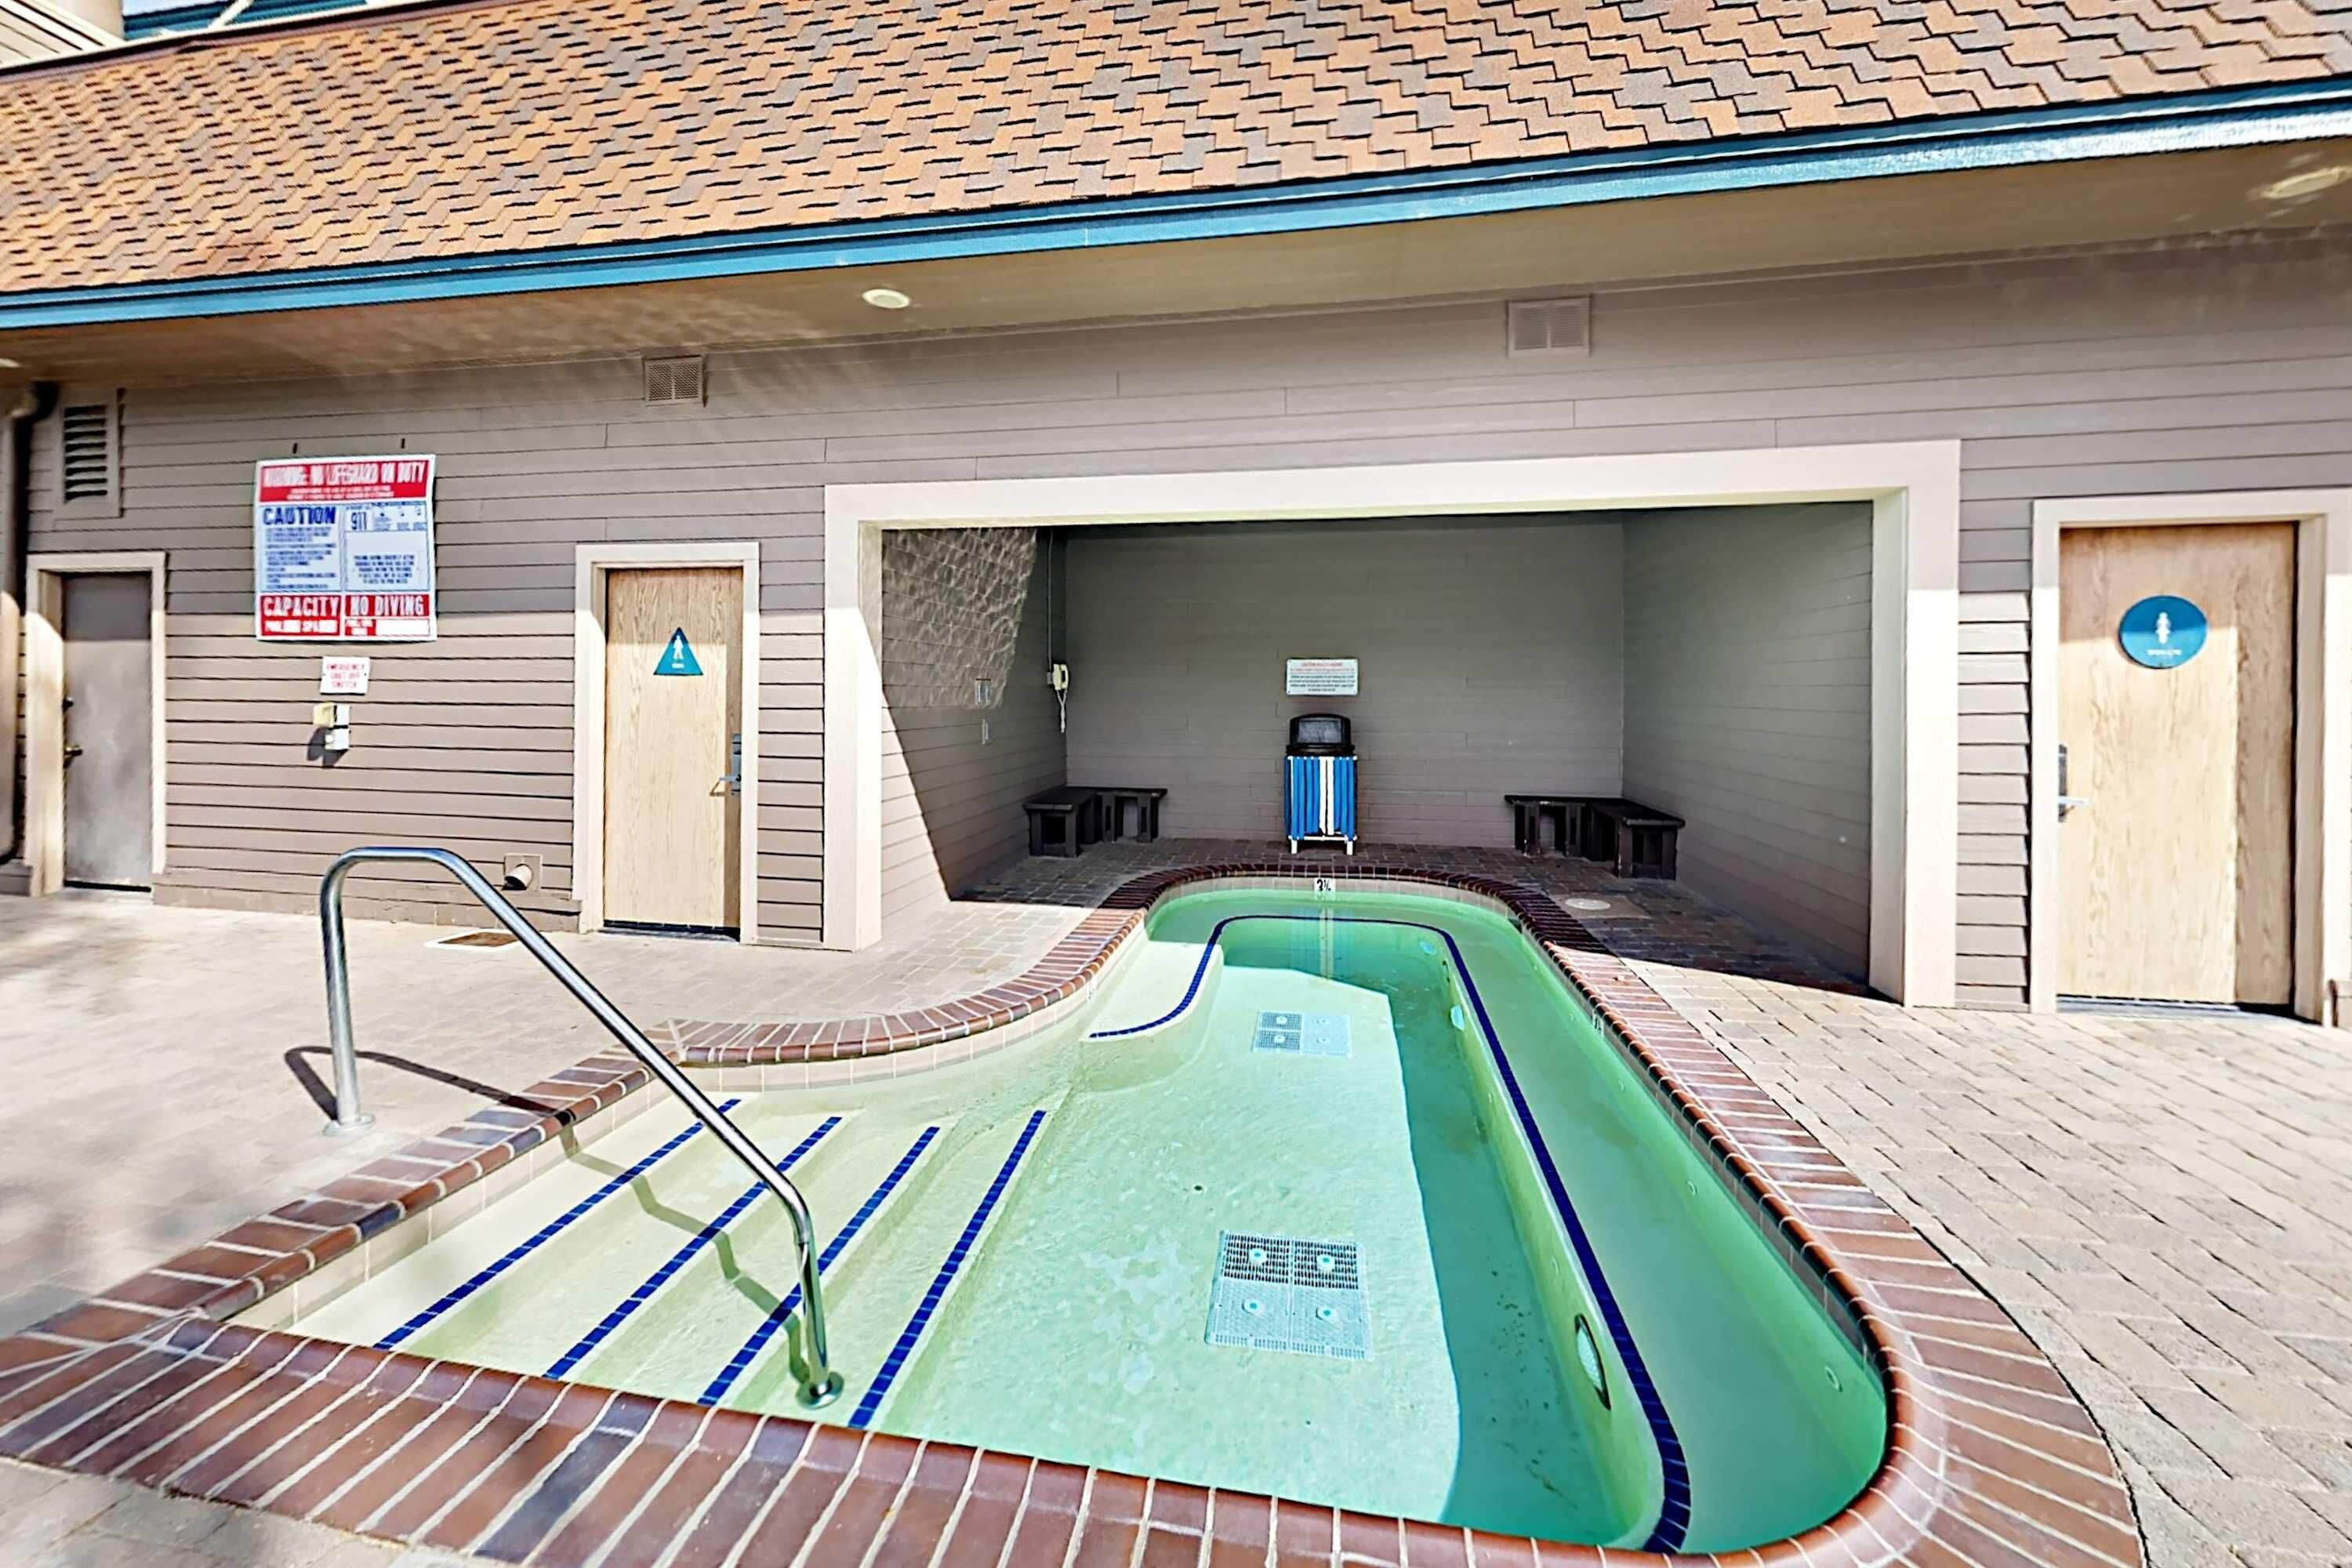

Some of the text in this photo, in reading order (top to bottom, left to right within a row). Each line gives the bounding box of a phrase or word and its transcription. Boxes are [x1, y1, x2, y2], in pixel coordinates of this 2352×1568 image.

[397, 461, 426, 483] DUTY
[263, 506, 336, 525] CAUTION
[351, 511, 367, 530] 911
[263, 597, 339, 616] CAPACITY
[350, 595, 424, 615] NO DIVING
